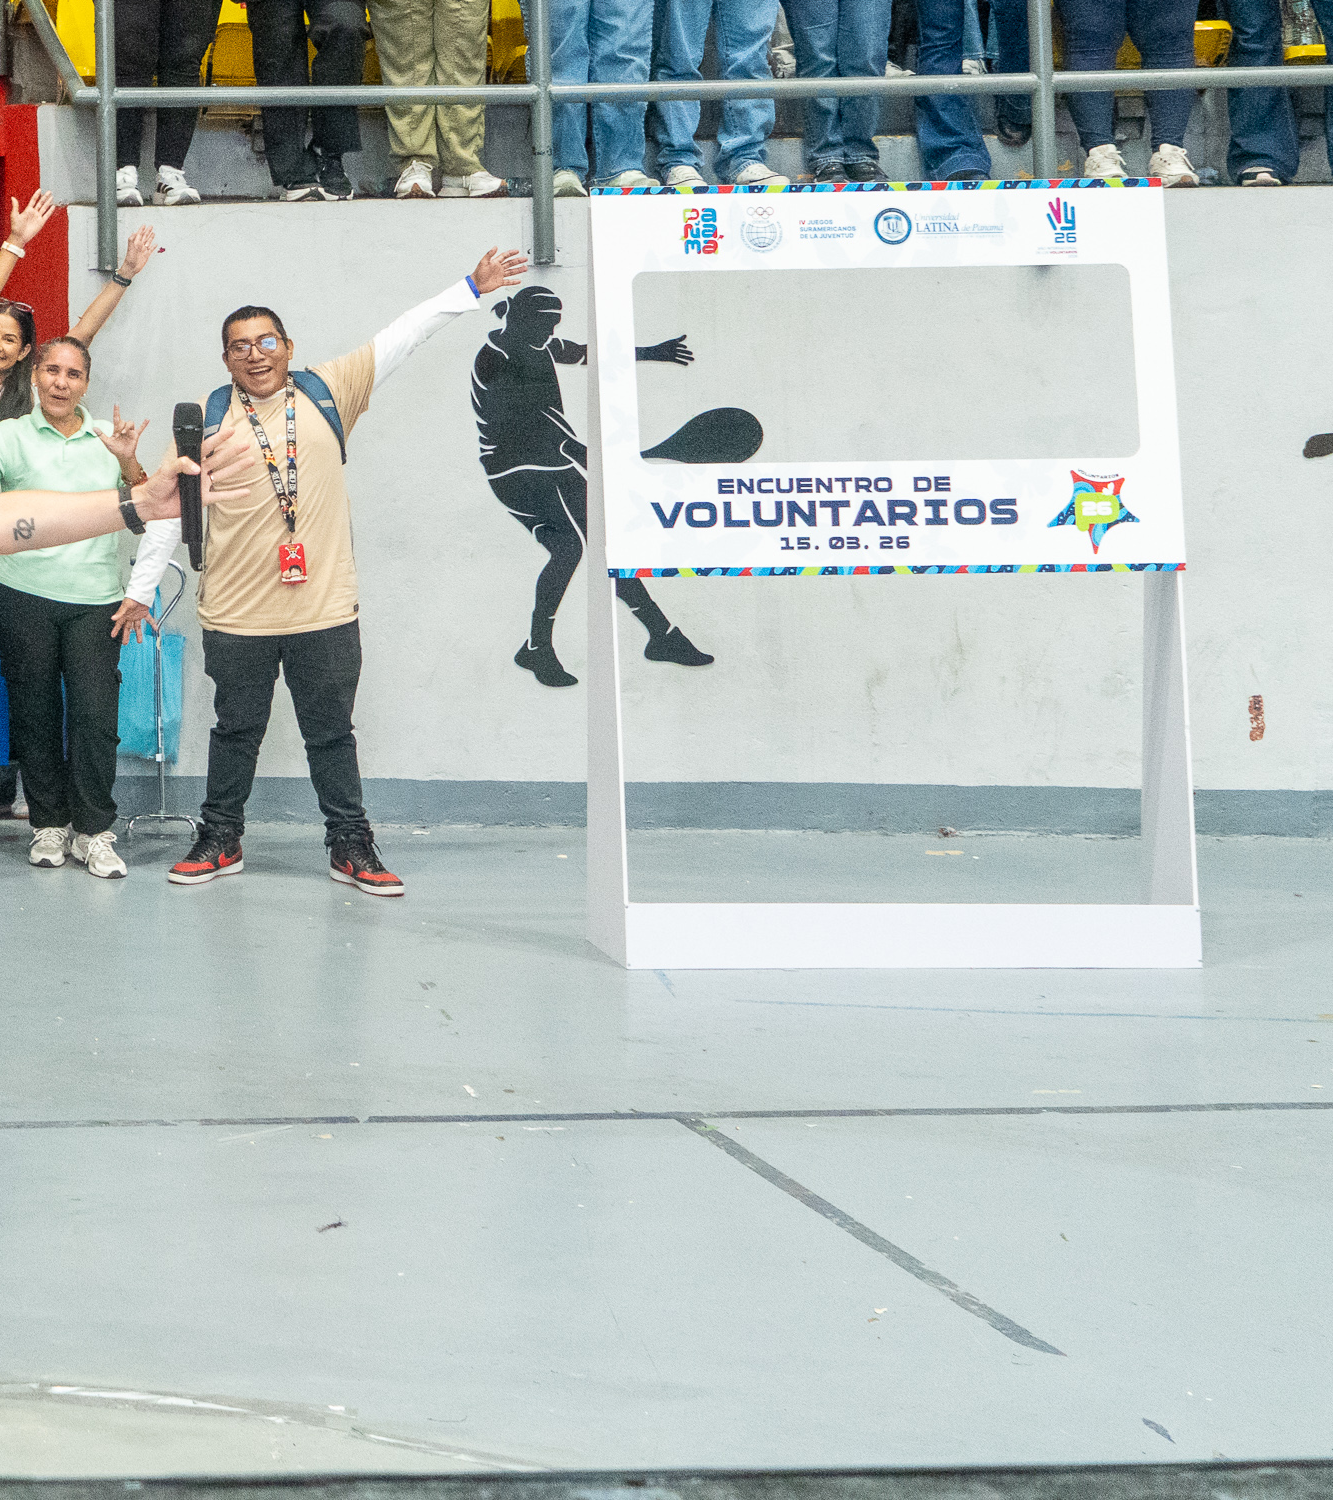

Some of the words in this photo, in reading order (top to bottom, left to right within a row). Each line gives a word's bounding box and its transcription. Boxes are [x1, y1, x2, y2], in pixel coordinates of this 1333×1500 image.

[914, 212, 960, 221] Universidad
[916, 222, 960, 232] LATINA
[961, 223, 971, 232] de
[972, 222, 1004, 232] Panamá
[1054, 232, 1077, 243] 26
[1077, 468, 1120, 479] VOLUNTARIOS
[717, 477, 893, 494] ENCUENTRO
[913, 476, 951, 492] DE
[651, 498, 1019, 528] VOLUNTARIOS
[1081, 500, 1113, 516] 26
